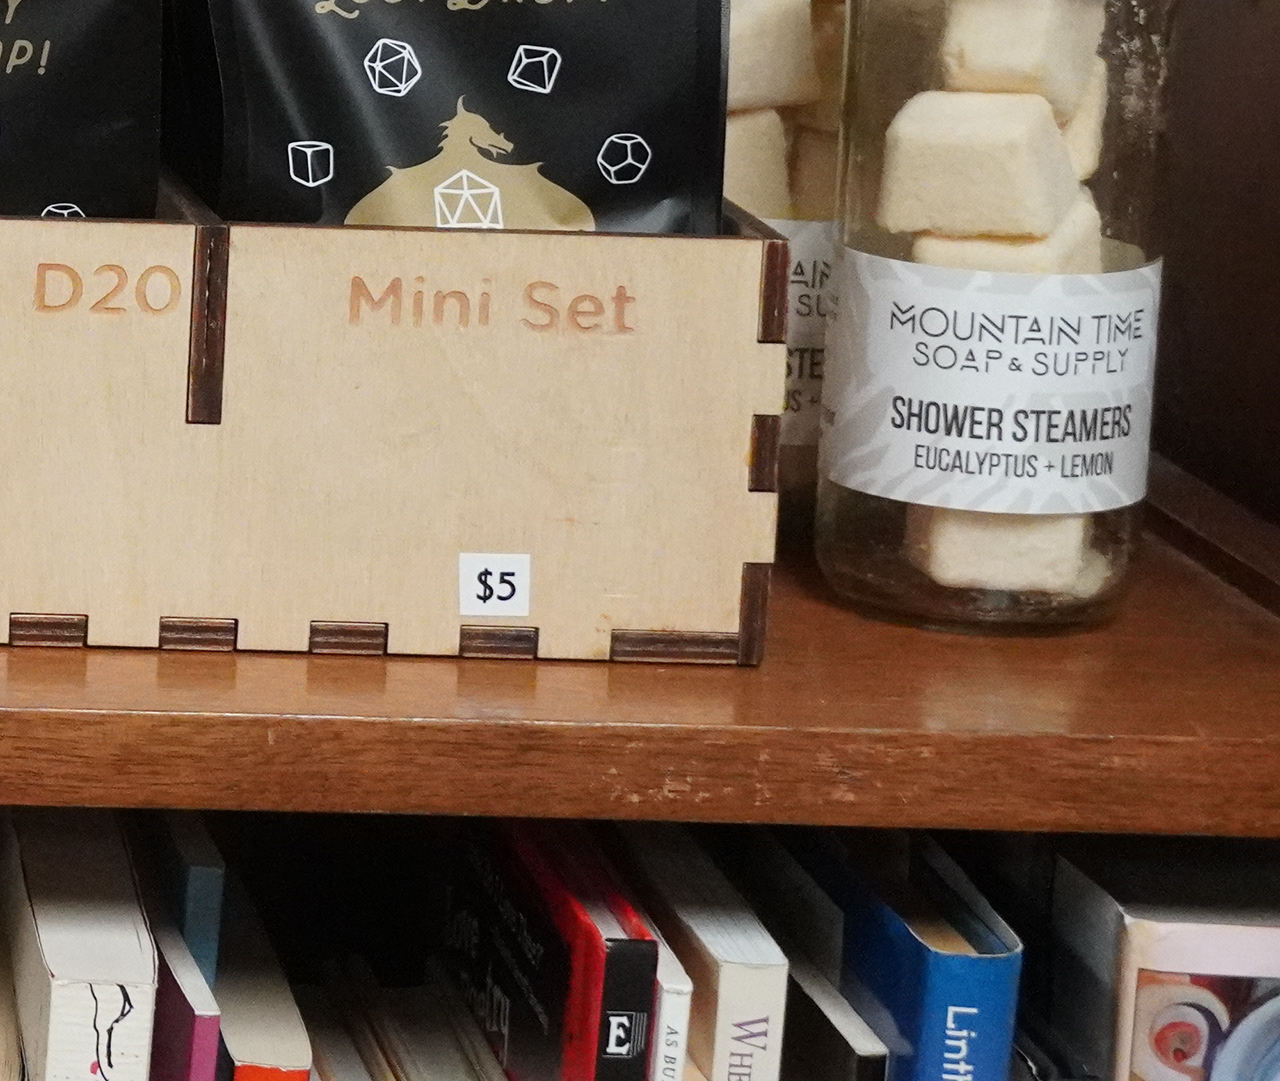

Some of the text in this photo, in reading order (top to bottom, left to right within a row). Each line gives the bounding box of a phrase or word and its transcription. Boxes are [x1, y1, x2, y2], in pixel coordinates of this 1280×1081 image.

[33, 262, 182, 315] D20
[349, 275, 637, 333] Mini Set
[890, 301, 1144, 345] MOUNTAIN TIME
[913, 342, 1128, 376] SOAP & SUPPLY
[891, 395, 1132, 443] SHOWER STEAMERS
[914, 444, 1114, 478] EUCALYPTUS + LEMON
[476, 568, 517, 603] $5
[662, 1054, 677, 1081] BU
